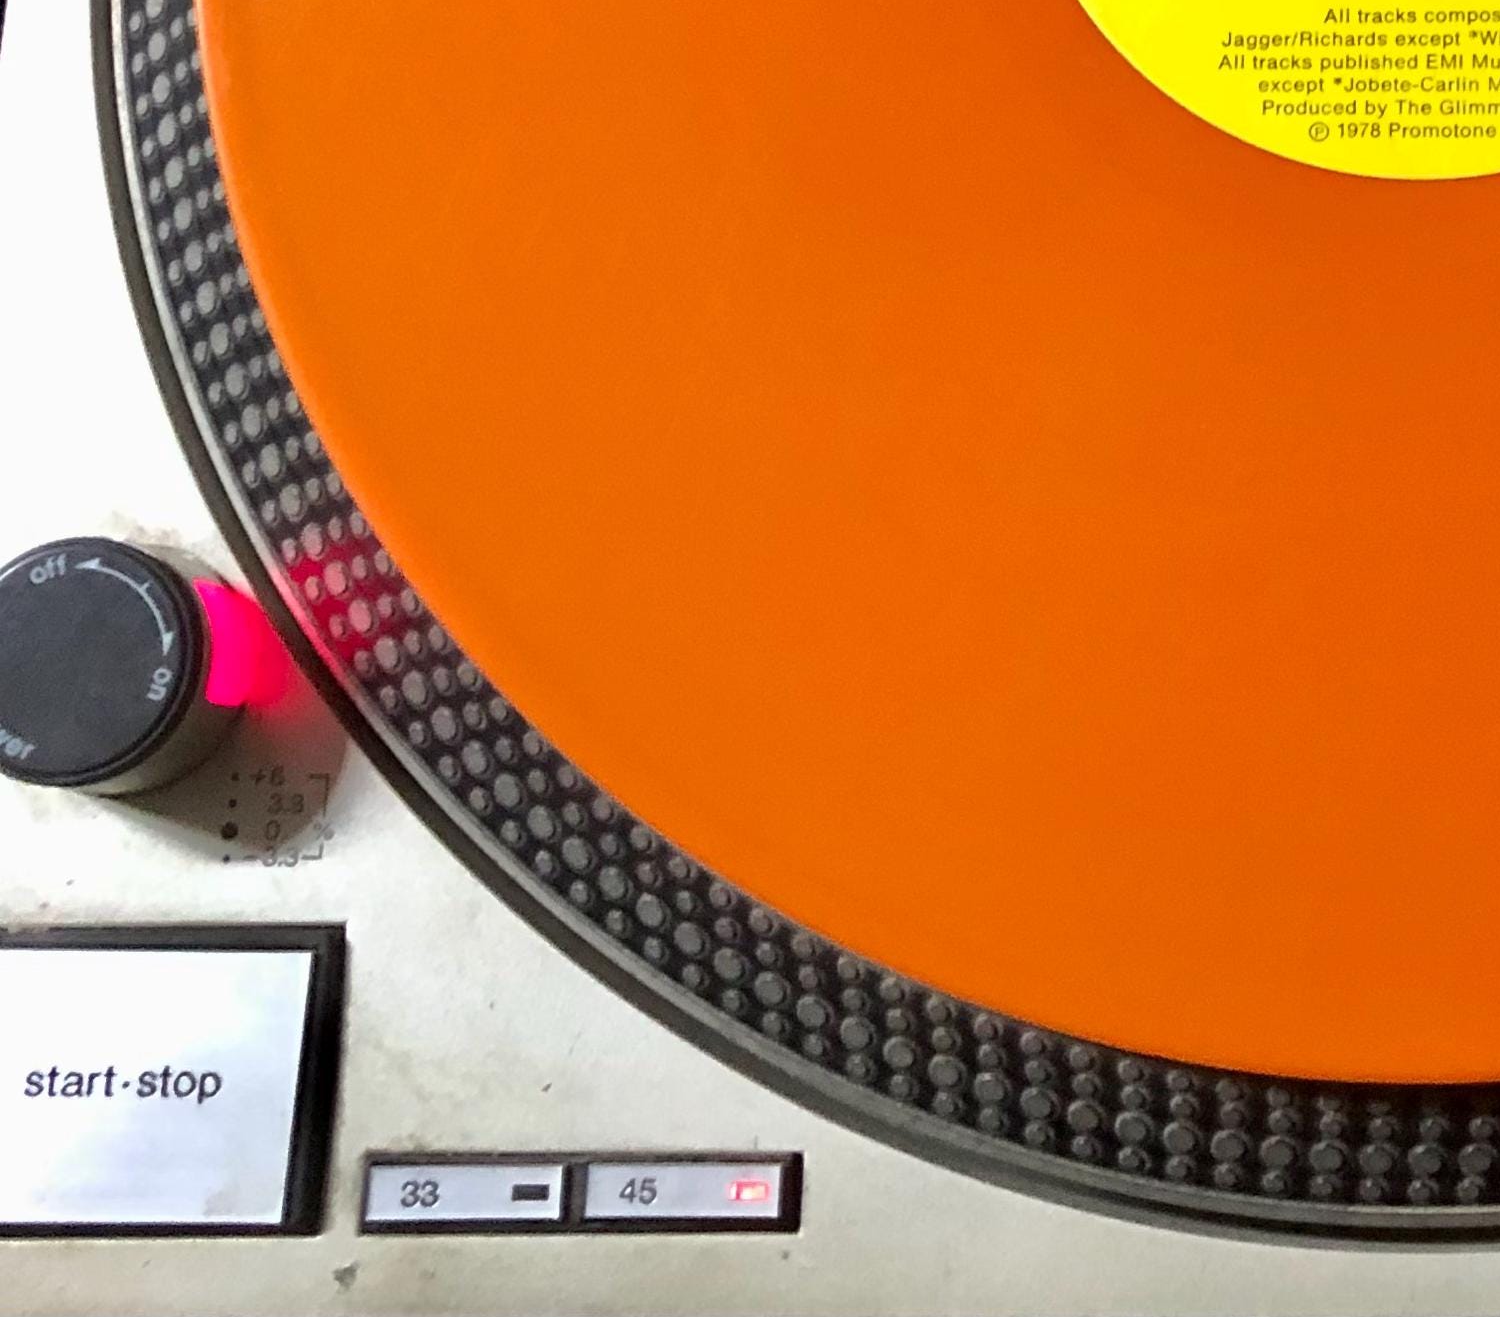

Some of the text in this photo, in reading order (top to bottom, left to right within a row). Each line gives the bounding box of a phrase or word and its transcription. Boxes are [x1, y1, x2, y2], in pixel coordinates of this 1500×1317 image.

[1323, 7, 1351, 24] All
[1357, 7, 1418, 25] tracks
[1221, 30, 1388, 52] Jagger/Richards
[1394, 31, 1461, 50] except
[1217, 53, 1245, 71] All
[1252, 54, 1313, 71] tracks
[1319, 53, 1419, 74] published
[1425, 52, 1464, 71] EMI
[1257, 77, 1325, 97] except
[1261, 99, 1357, 117] Produced
[1364, 99, 1388, 120] by
[1395, 98, 1433, 116] The
[1337, 121, 1382, 139] 1978
[1387, 121, 1497, 139] Promotone
[29, 553, 67, 584] off
[146, 667, 173, 701] on
[265, 820, 280, 841] 0
[400, 1178, 440, 1209] 33
[618, 1176, 658, 1206] 45
